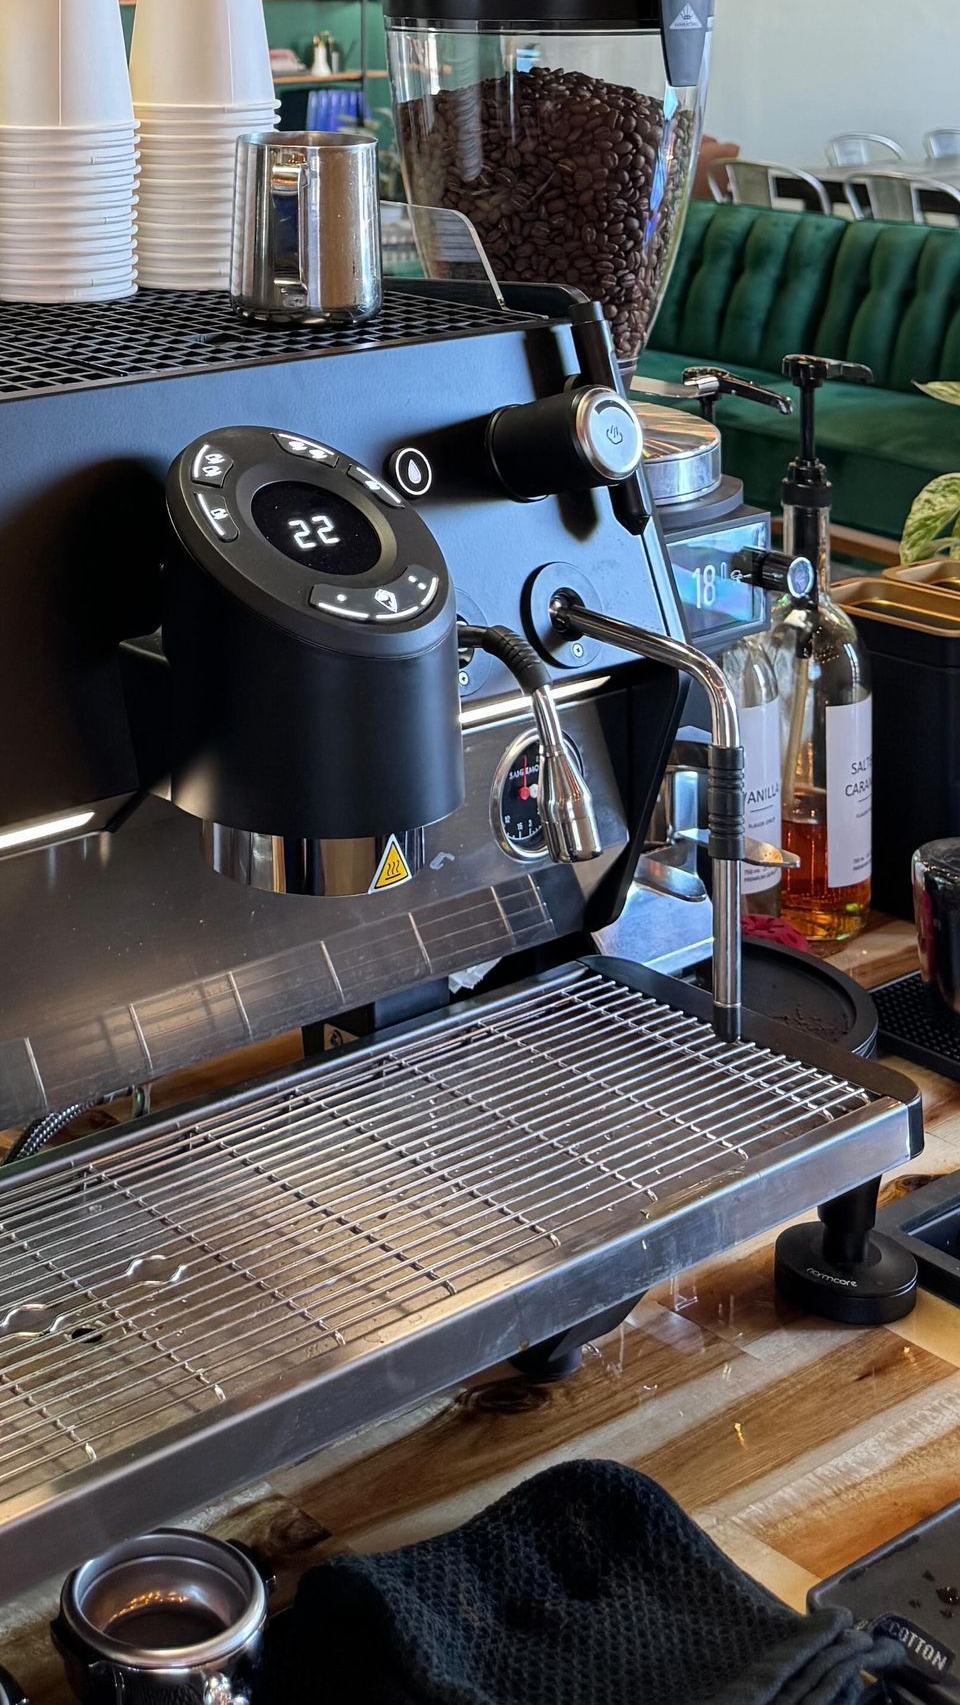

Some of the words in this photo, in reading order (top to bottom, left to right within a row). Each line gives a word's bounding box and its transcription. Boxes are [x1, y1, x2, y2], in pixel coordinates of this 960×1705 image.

[288, 515, 341, 549] 22
[806, 1267, 858, 1287] normcore
[888, 1621, 948, 1671] COTTON
